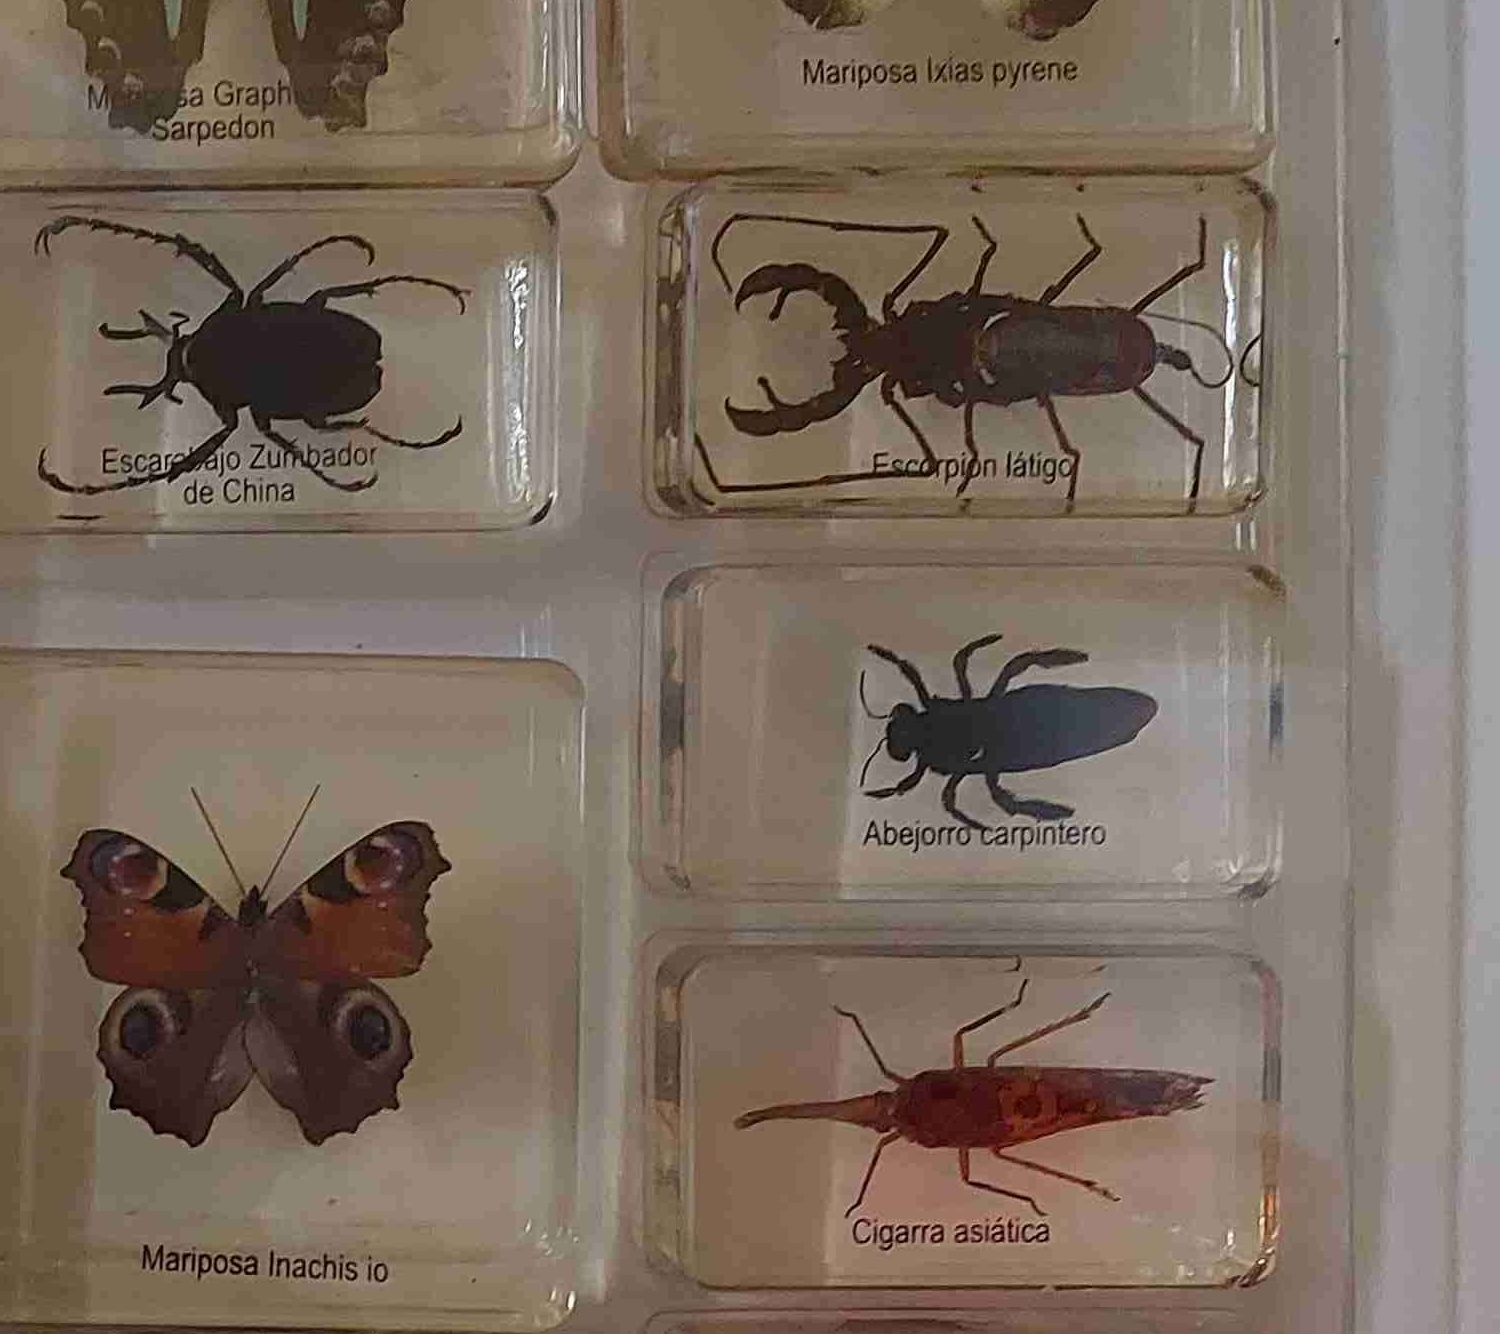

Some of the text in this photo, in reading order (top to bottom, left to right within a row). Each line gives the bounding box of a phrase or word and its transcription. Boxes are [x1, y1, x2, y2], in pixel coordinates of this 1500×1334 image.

[803, 54, 1078, 89] Mariposa Ixias pyrene
[152, 115, 275, 147] Sarpedon
[1006, 450, 1073, 484] látigo
[184, 478, 295, 505] de China
[863, 819, 1106, 853] Abejorro carpintero
[852, 1216, 1050, 1251] Cigarra asiática
[142, 1244, 389, 1283] Mariposa Inachis io
